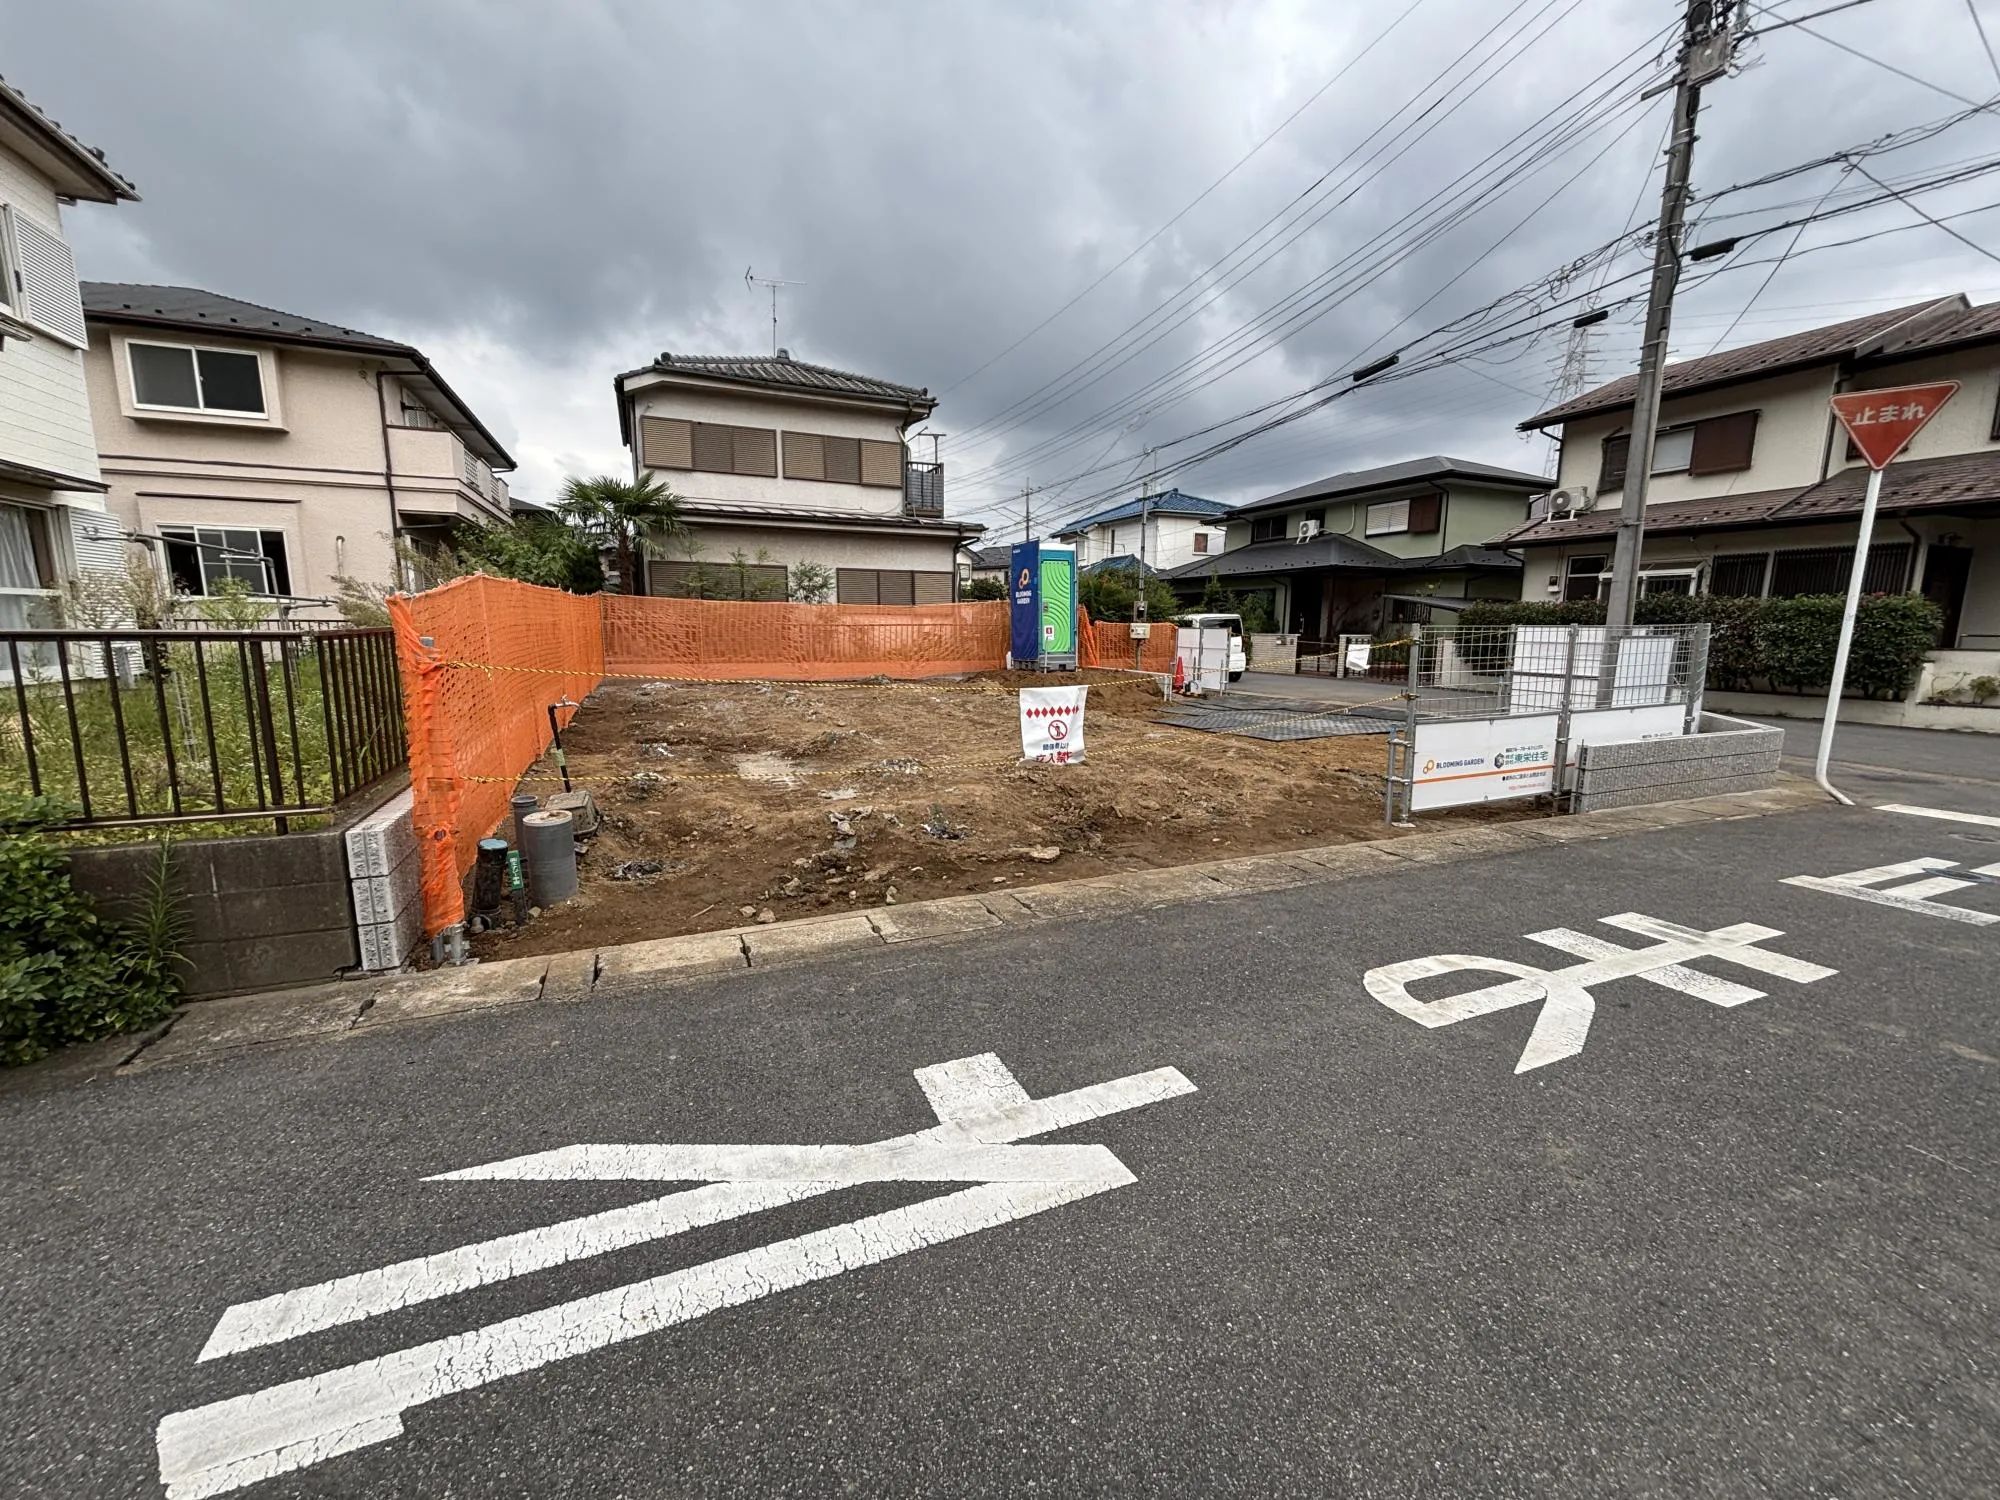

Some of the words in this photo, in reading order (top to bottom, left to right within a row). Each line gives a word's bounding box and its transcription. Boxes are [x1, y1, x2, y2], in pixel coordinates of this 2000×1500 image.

[1852, 402, 1926, 426] 止まれ
[1436, 760, 1463, 769] BLOOMING
[1464, 757, 1485, 767] GARDEN
[1514, 751, 1549, 763] 東栄住宅
